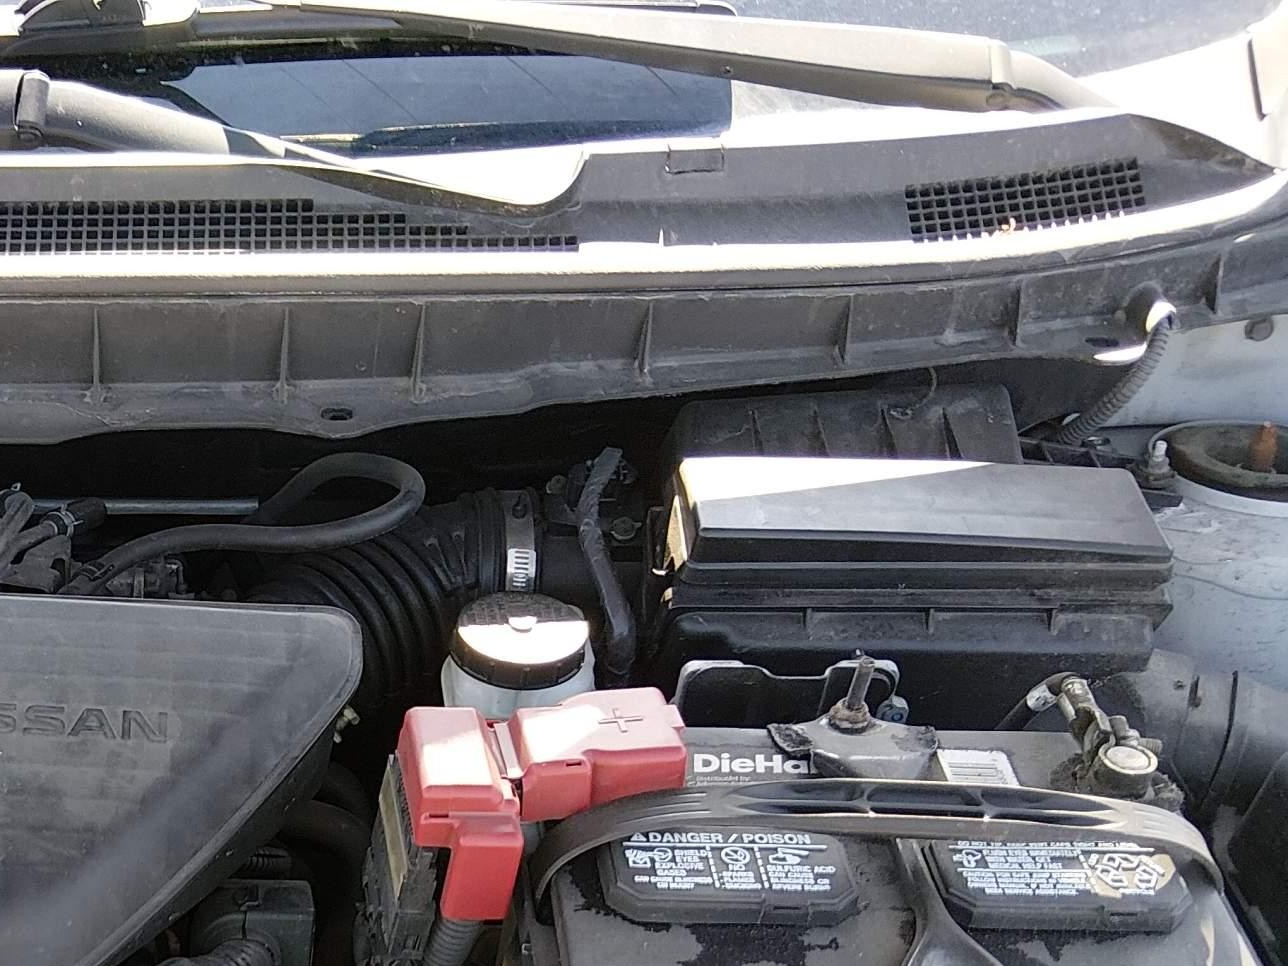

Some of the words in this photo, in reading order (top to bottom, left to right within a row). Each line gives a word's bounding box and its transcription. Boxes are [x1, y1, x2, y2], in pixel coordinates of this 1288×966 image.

[693, 752, 809, 775] DieHa
[648, 832, 723, 844] DANGER
[727, 833, 739, 844] /
[742, 833, 812, 845] POISON
[813, 865, 837, 874] ACID
